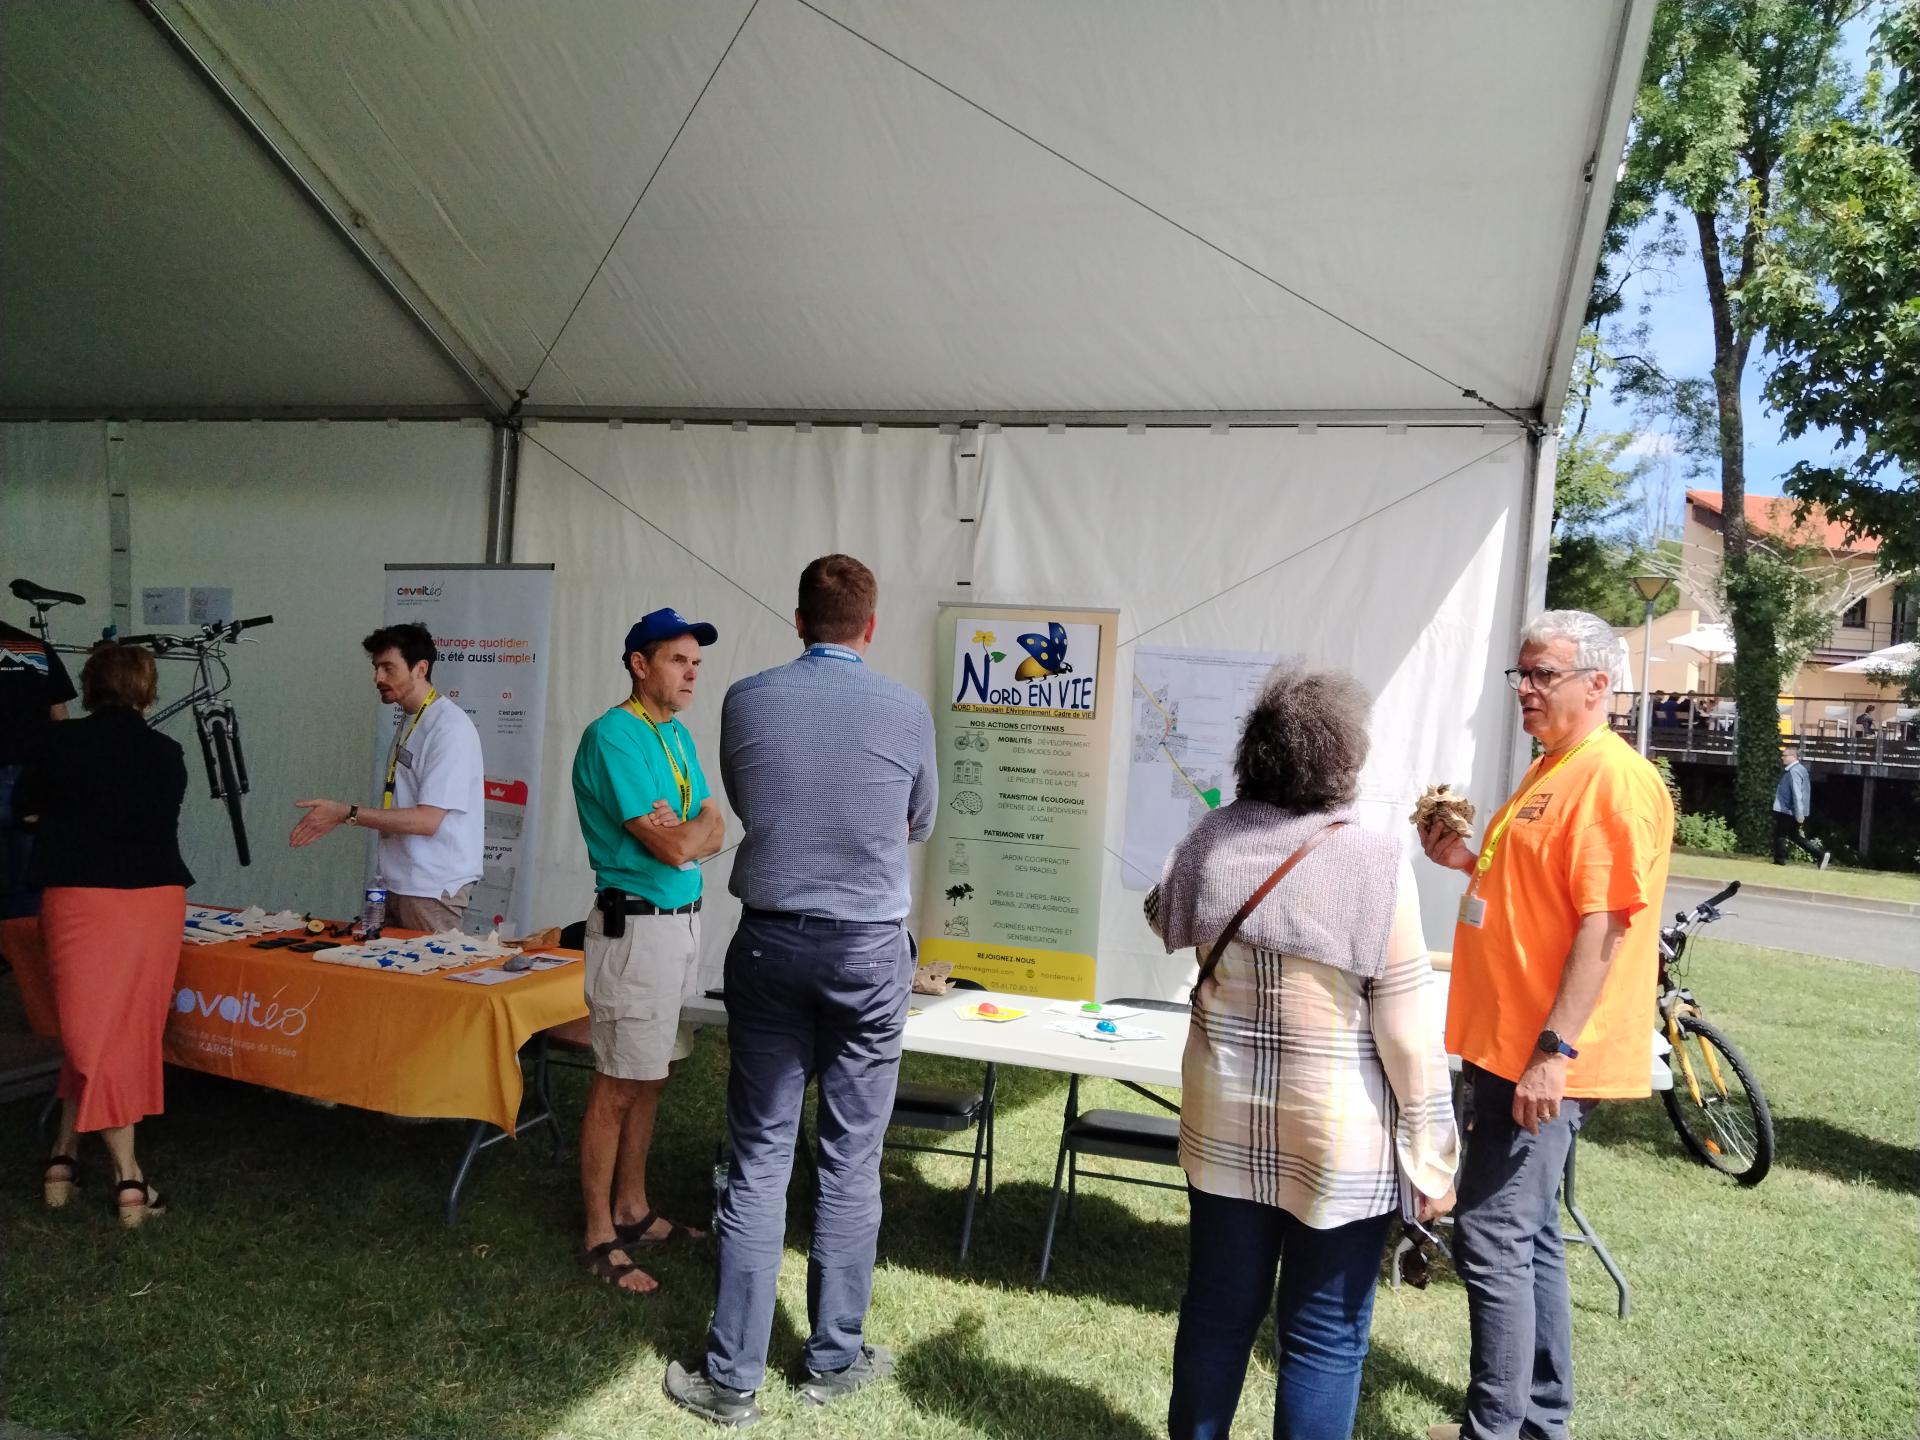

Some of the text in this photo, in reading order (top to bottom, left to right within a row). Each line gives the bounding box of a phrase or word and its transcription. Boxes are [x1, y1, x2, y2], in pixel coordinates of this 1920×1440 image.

[432, 637, 528, 651] oiturage quotidien
[448, 650, 464, 663] été
[467, 651, 496, 663] aussi
[497, 652, 531, 665] simple
[957, 652, 1093, 709] NORD EN VIE
[953, 704, 971, 712] NORD
[973, 705, 1003, 713] Toulousain
[970, 720, 1065, 733] NOS ACTIONS CITOYENNES
[998, 735, 1032, 745] MOBILITÉS
[1029, 748, 1050, 756] MODES
[998, 765, 1036, 774] URBANISME
[1015, 777, 1043, 785] PROJETS
[998, 792, 1085, 806] TRANSITION ÉCOLOGIQUE
[1030, 815, 1054, 823] LOCALE
[984, 829, 1044, 841] PATRIMOINE VERT
[1000, 853, 1023, 862] JARDIN
[996, 889, 1014, 897] RIVES
[1042, 904, 1079, 914] AGRICOLES
[1027, 925, 1062, 935] NETTOYAGE
[175, 984, 320, 1036] ovoitéo
